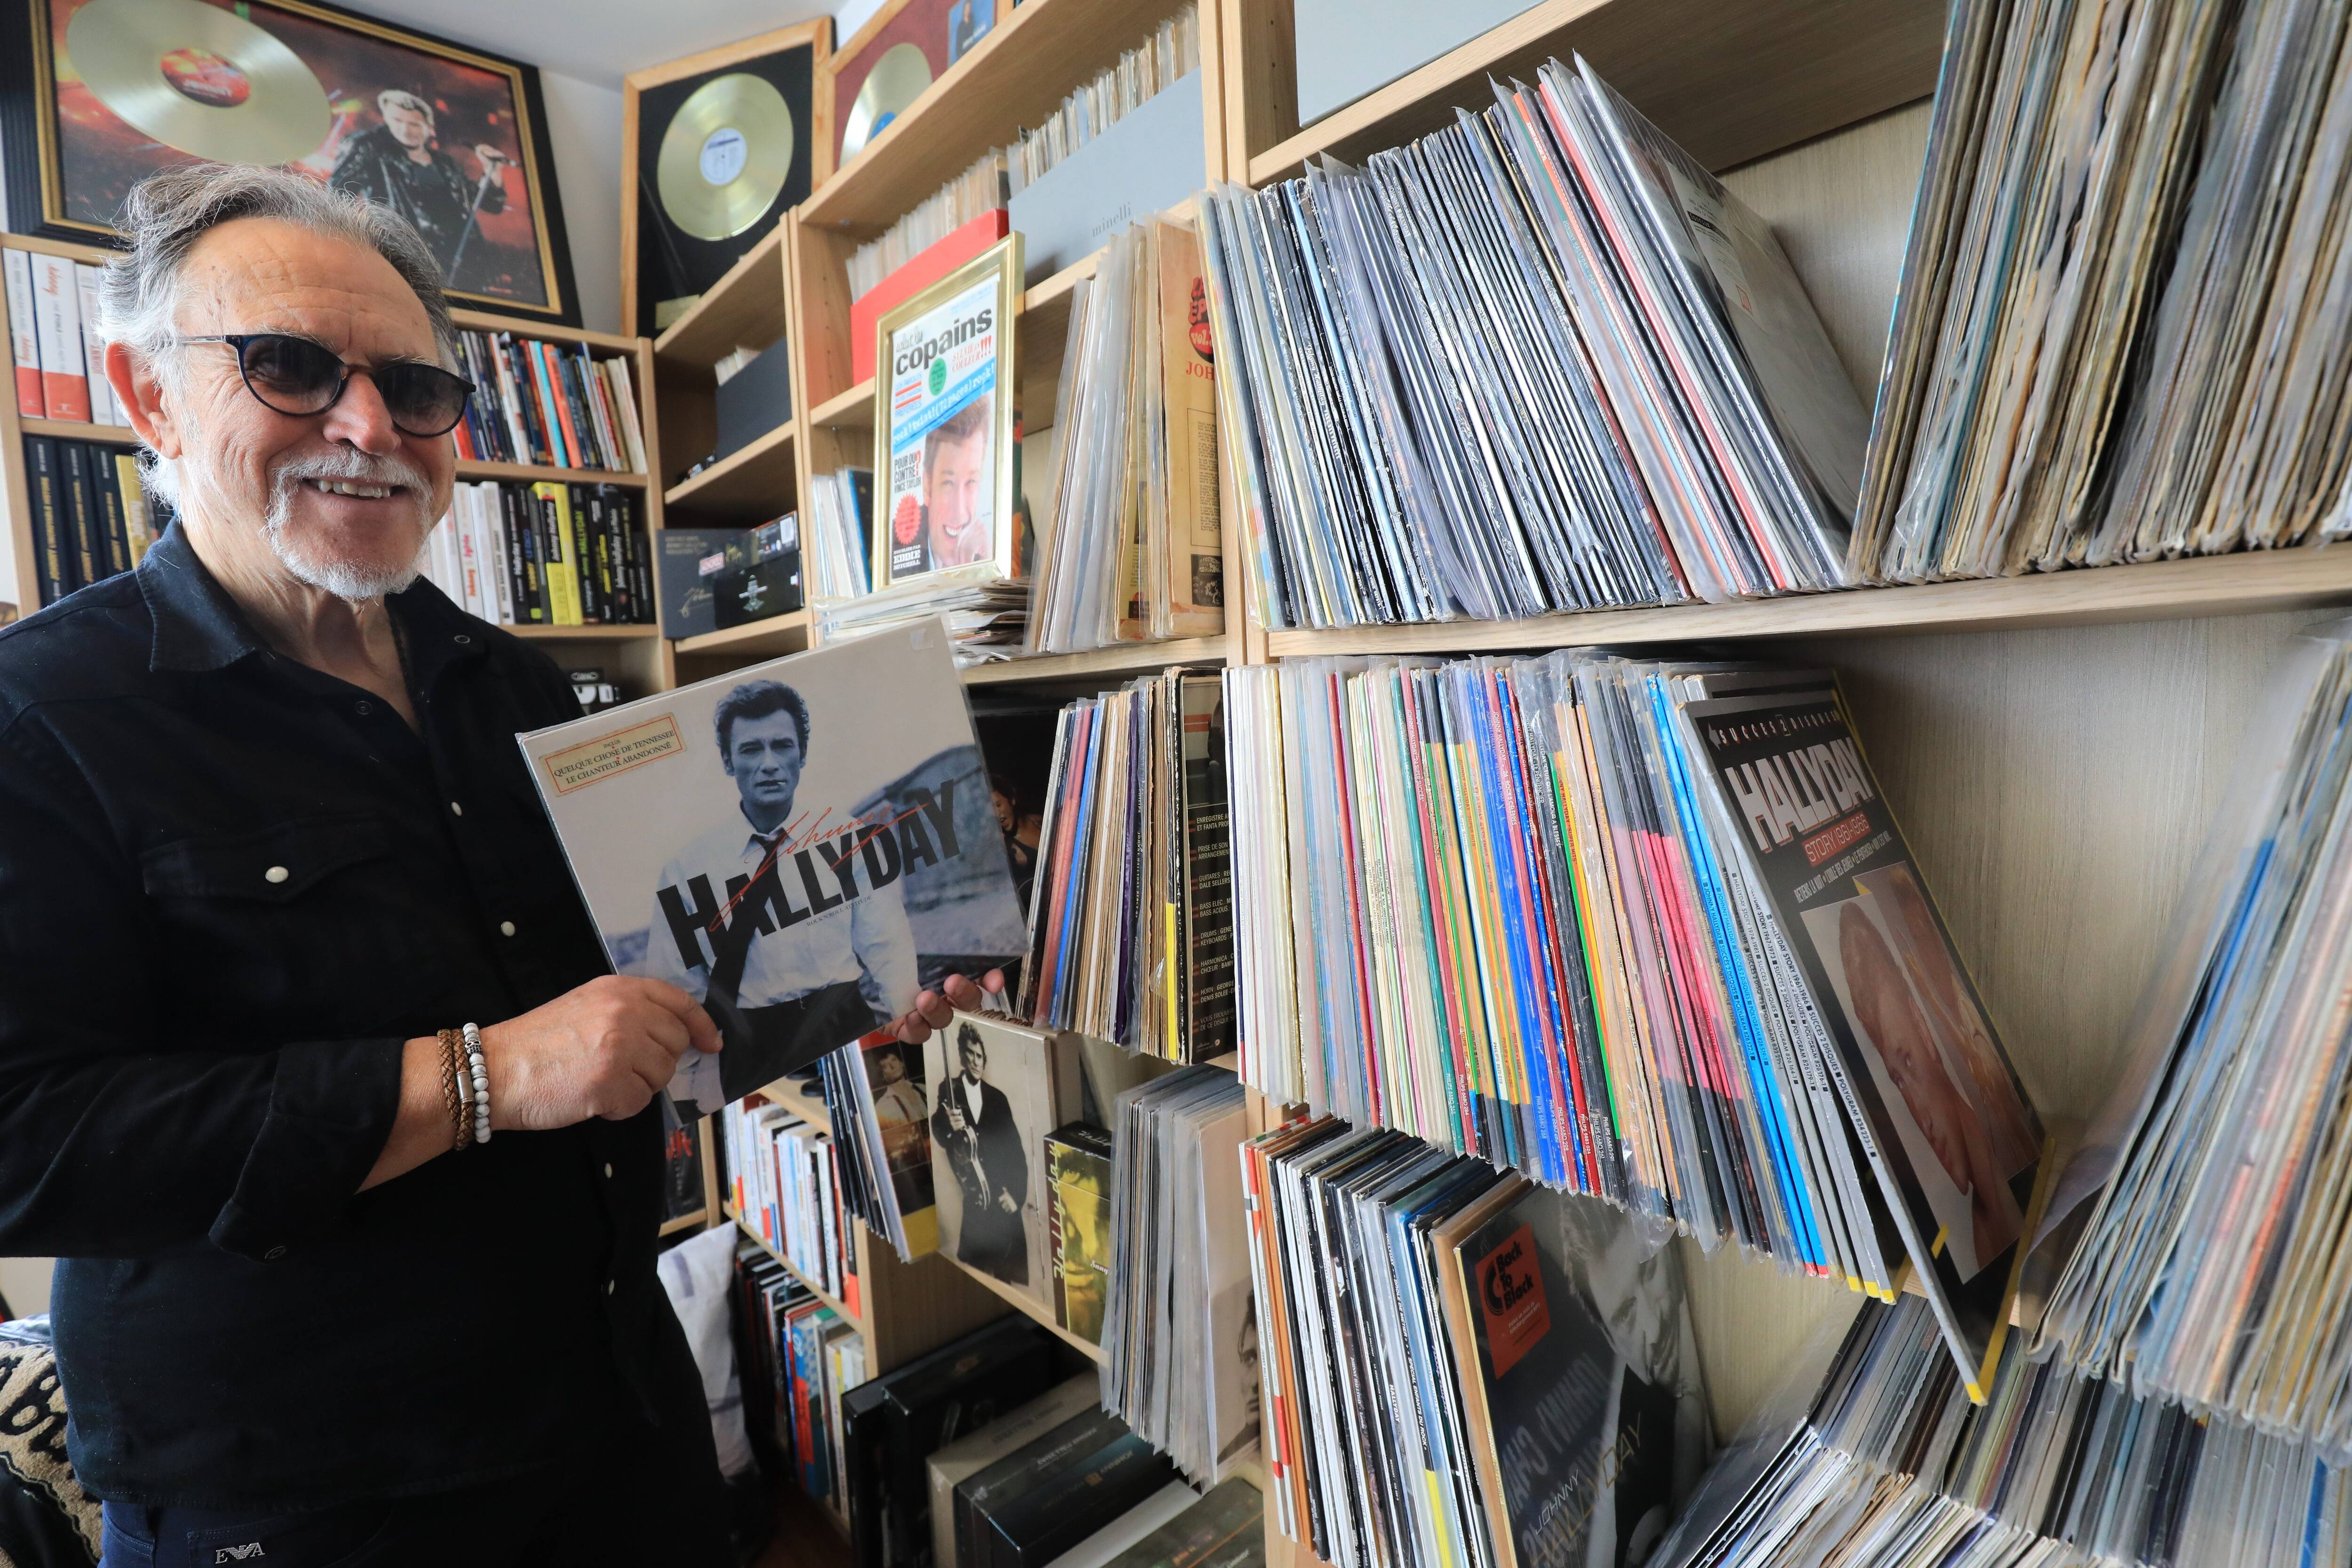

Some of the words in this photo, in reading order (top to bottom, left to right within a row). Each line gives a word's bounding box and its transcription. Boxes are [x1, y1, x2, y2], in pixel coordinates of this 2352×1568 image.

[1526, 120, 1536, 137] JOHNNY
[1533, 136, 1544, 155] HALLYDAY
[1444, 162, 1457, 185] HALLYDAY
[1451, 158, 1464, 181] HALLYDAY
[1387, 184, 1400, 207] JOHNNY
[1396, 208, 1411, 237] HALLYDAY
[1415, 180, 1428, 203] JOHNNY
[1424, 204, 1439, 233] HALLYDAY
[1423, 175, 1437, 198] JOHNNY
[1432, 198, 1449, 228] HALLYDAY
[1092, 202, 1131, 236] minelli
[1465, 308, 1478, 334] PICTURE
[1476, 302, 1490, 328] PICTURE
[896, 308, 992, 375] copains
[894, 455, 908, 470] POUR
[908, 452, 915, 465] OU
[894, 466, 915, 484] CONTRE
[894, 481, 906, 493] VINCE
[906, 476, 921, 489] TAYLOR
[1779, 462, 1800, 495] MERCURY
[893, 549, 921, 564] EDDIE
[893, 559, 921, 571] MITCHELL
[604, 740, 620, 748] INCLUS
[1493, 710, 1501, 732] JOHNNY
[1497, 734, 1506, 761] HALLYDAY
[1528, 732, 1537, 760] HALLYDAY
[554, 758, 592, 777] QUELQUE
[594, 749, 620, 763] CHOSE
[621, 745, 633, 754] DE
[633, 730, 675, 748] TENNESSEE
[577, 760, 621, 780] CHANTEUR
[623, 742, 672, 764] ABANDONNÉ
[1462, 783, 1470, 810] HALLYDAY
[1560, 793, 1570, 823] HALLYDAY
[1725, 737, 1874, 852] HALLYDAY
[1197, 814, 1224, 823] ENREGISTRE
[1805, 832, 1836, 862] STORY
[1834, 814, 1869, 845] 1961-1966
[656, 779, 960, 970] HALLYDAY
[1199, 873, 1220, 882] GUITARES
[1212, 877, 1230, 887] SELLERS
[845, 896, 872, 911] ATTITUDE
[1200, 908, 1211, 917] BASS
[1200, 929, 1217, 939] DRUMS
[1220, 925, 1232, 934] GENE
[1201, 935, 1226, 947] KEYBOARDS
[1201, 955, 1227, 967] HARMONICA
[1221, 960, 1233, 969] BAMY
[1704, 887, 1715, 911] JOHNNY
[1710, 912, 1723, 939] HALLYDAY
[1726, 970, 1738, 995] DISQUES
[1734, 1000, 1748, 1030] POLYGRAM
[1717, 892, 1728, 916] JOHNNY
[1724, 917, 1736, 944] HALLYDAY
[1740, 976, 1751, 1000] DISQUES
[1748, 1005, 1761, 1036] POLYGRAM
[1201, 986, 1213, 995] HORN
[1217, 980, 1234, 990] GEORGE
[1733, 878, 1746, 907] HALLYDAY
[1741, 907, 1751, 926] STORY
[1747, 927, 1759, 953] 1974-1981
[1765, 987, 1777, 1012] DISQUES
[1775, 1019, 1789, 1051] POLYGRAM
[1788, 1064, 1797, 1079] 164-1
[1201, 994, 1214, 1003] DENIS
[1756, 911, 1767, 930] STORY
[1763, 931, 1776, 959] 1967-1973
[1781, 993, 1794, 1019] DISQUES
[1791, 1025, 1806, 1058] POLYGRAM
[1806, 1070, 1814, 1085] 179-1
[1214, 1018, 1230, 1027] DISQUE
[1676, 1030, 1685, 1053] FONTANA
[1783, 953, 1796, 973] STORY
[1792, 973, 1810, 1005] 1961-1966
[1822, 1042, 1839, 1071] DISQUES
[1838, 1078, 1859, 1116] POLYGRAM
[1855, 1117, 1865, 1130] 834
[1090, 1260, 1108, 1275] Sang
[1496, 1241, 1522, 1269] Back
[1500, 1272, 1512, 1288] To
[1503, 1274, 1534, 1310] Black
[1397, 1302, 1403, 1314] DE
[1413, 1385, 1422, 1415] ENFANTS
[1418, 1416, 1423, 1425] DU
[1389, 1384, 1400, 1423] HALLYDAY
[1535, 1469, 1579, 1534] JOHNNY
